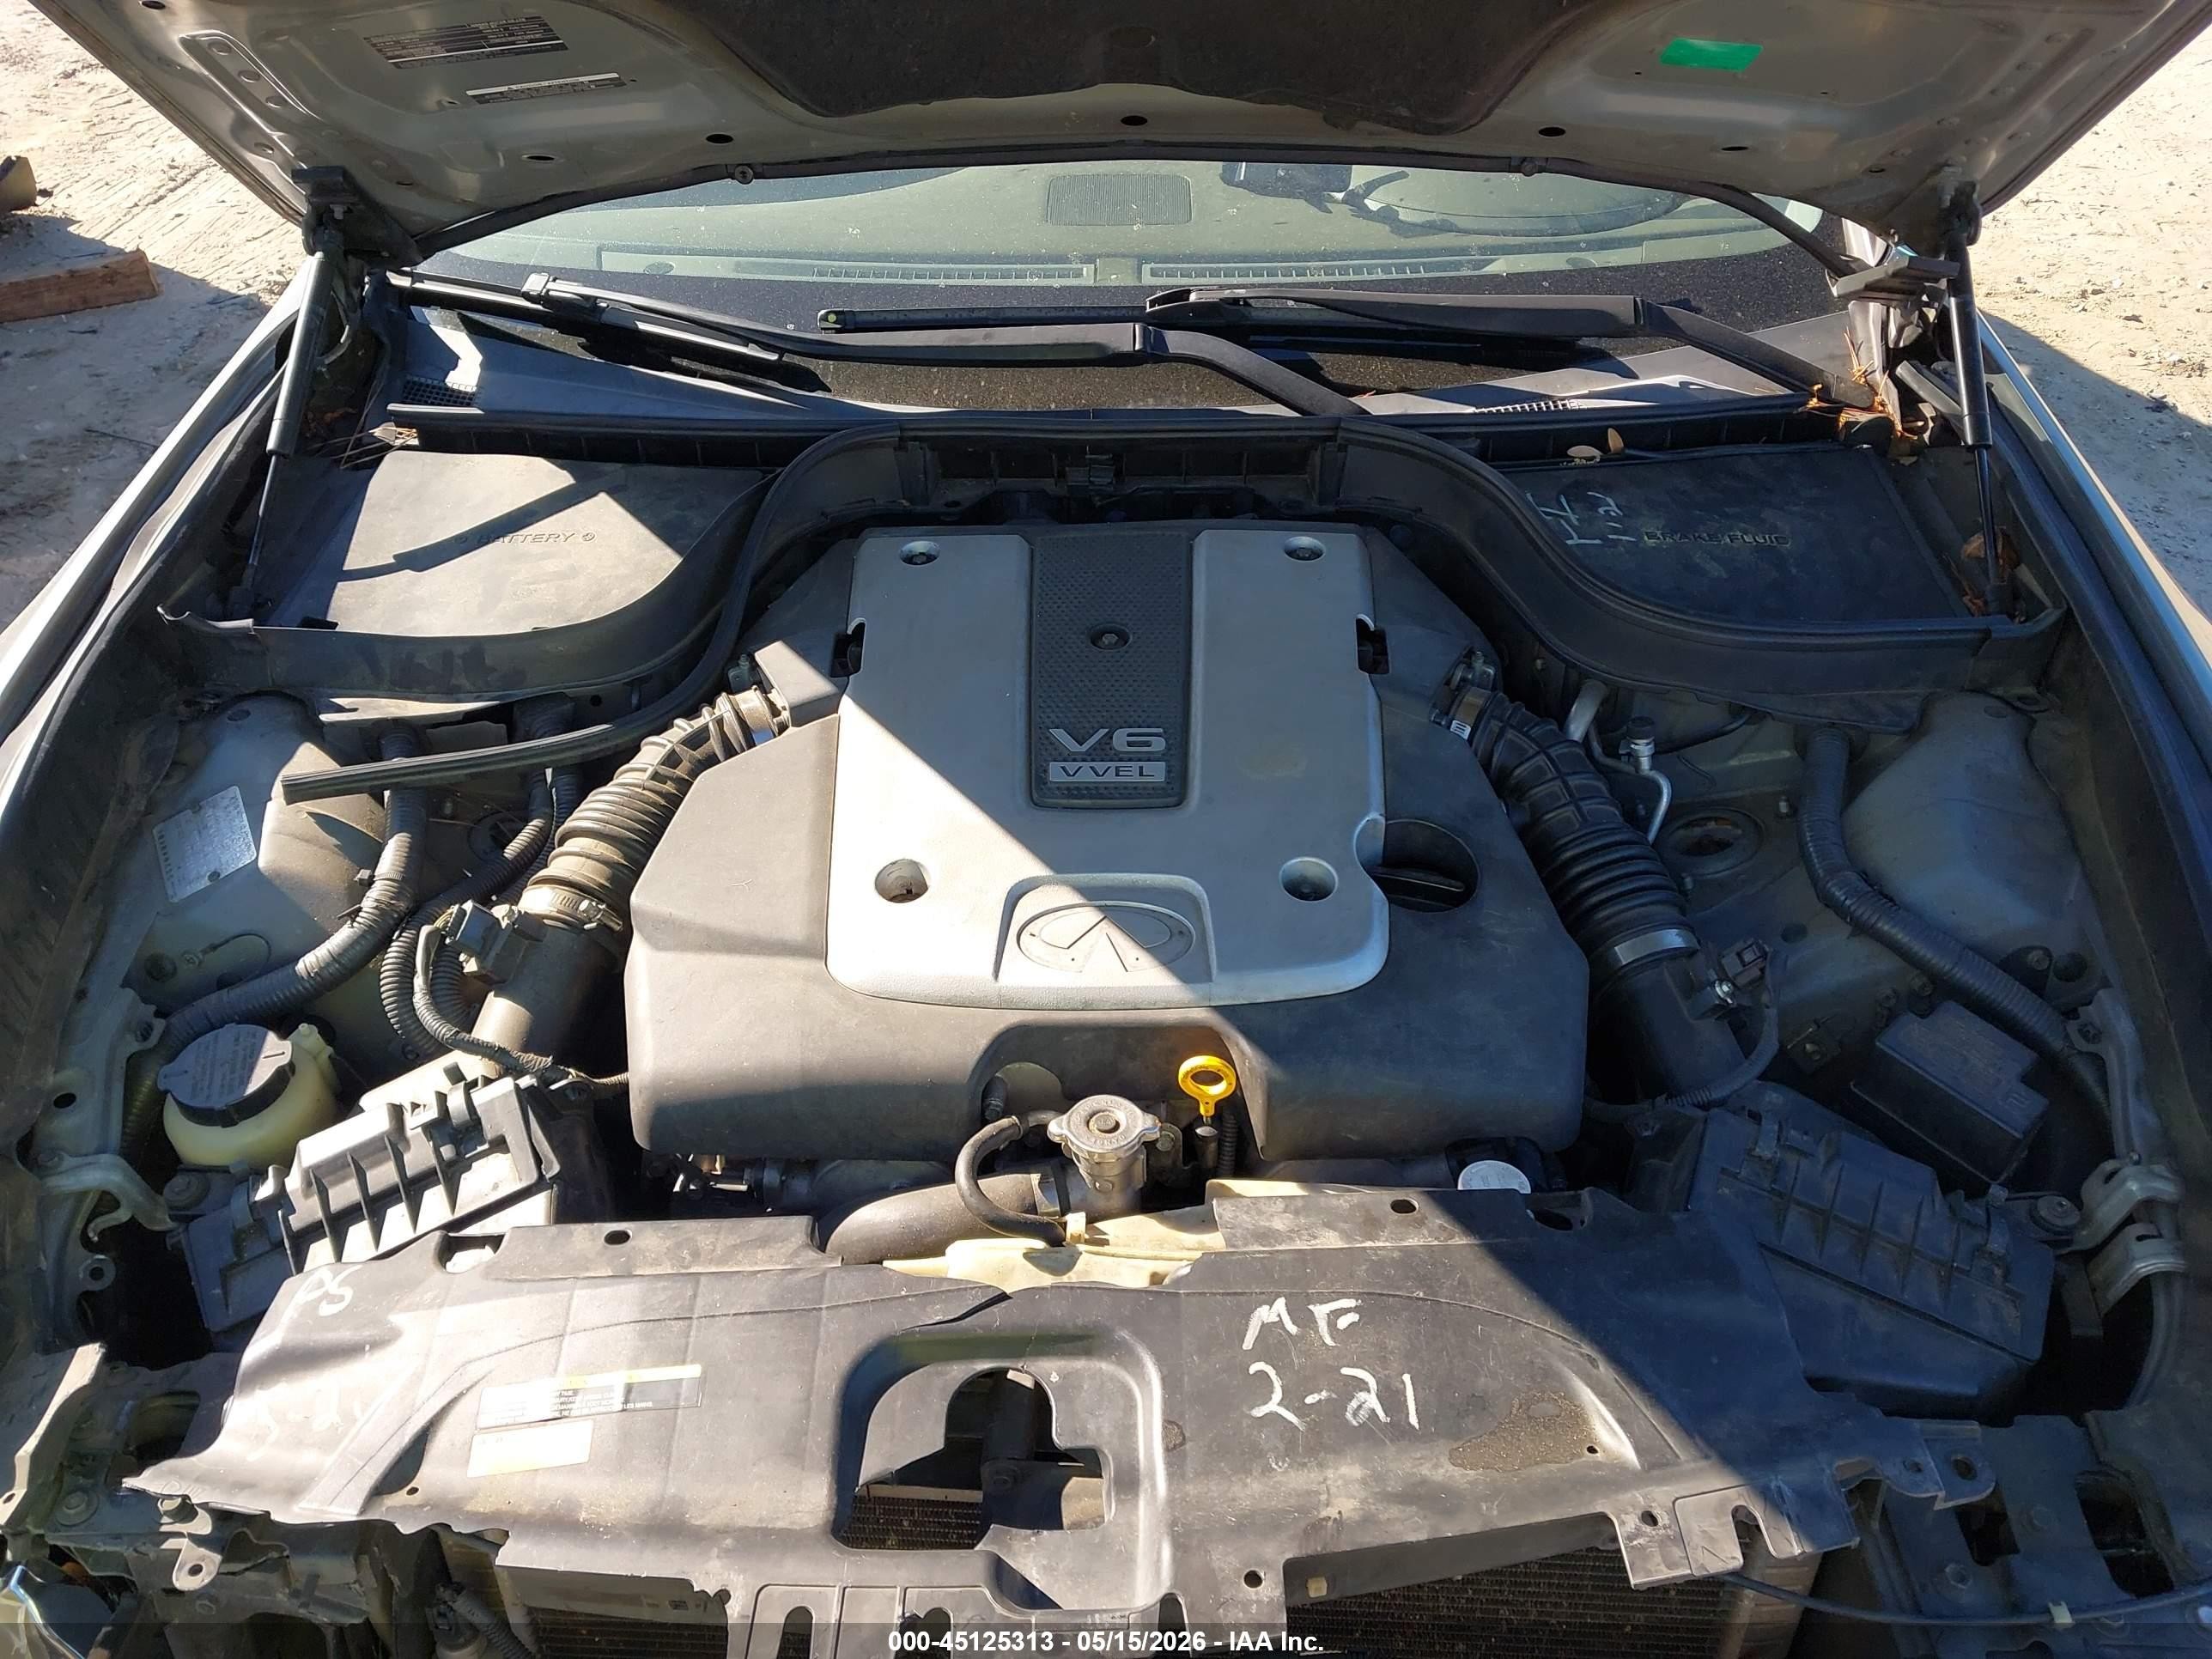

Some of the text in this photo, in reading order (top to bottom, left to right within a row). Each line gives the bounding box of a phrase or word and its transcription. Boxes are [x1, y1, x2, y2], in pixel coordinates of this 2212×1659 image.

[477, 532, 575, 544] BATTERY
[1644, 530, 1792, 548] BRAKE FLUID
[1048, 727, 1166, 752] V6
[1059, 765, 1155, 777] VVEL
[1248, 1361, 1419, 1431] 2-21
